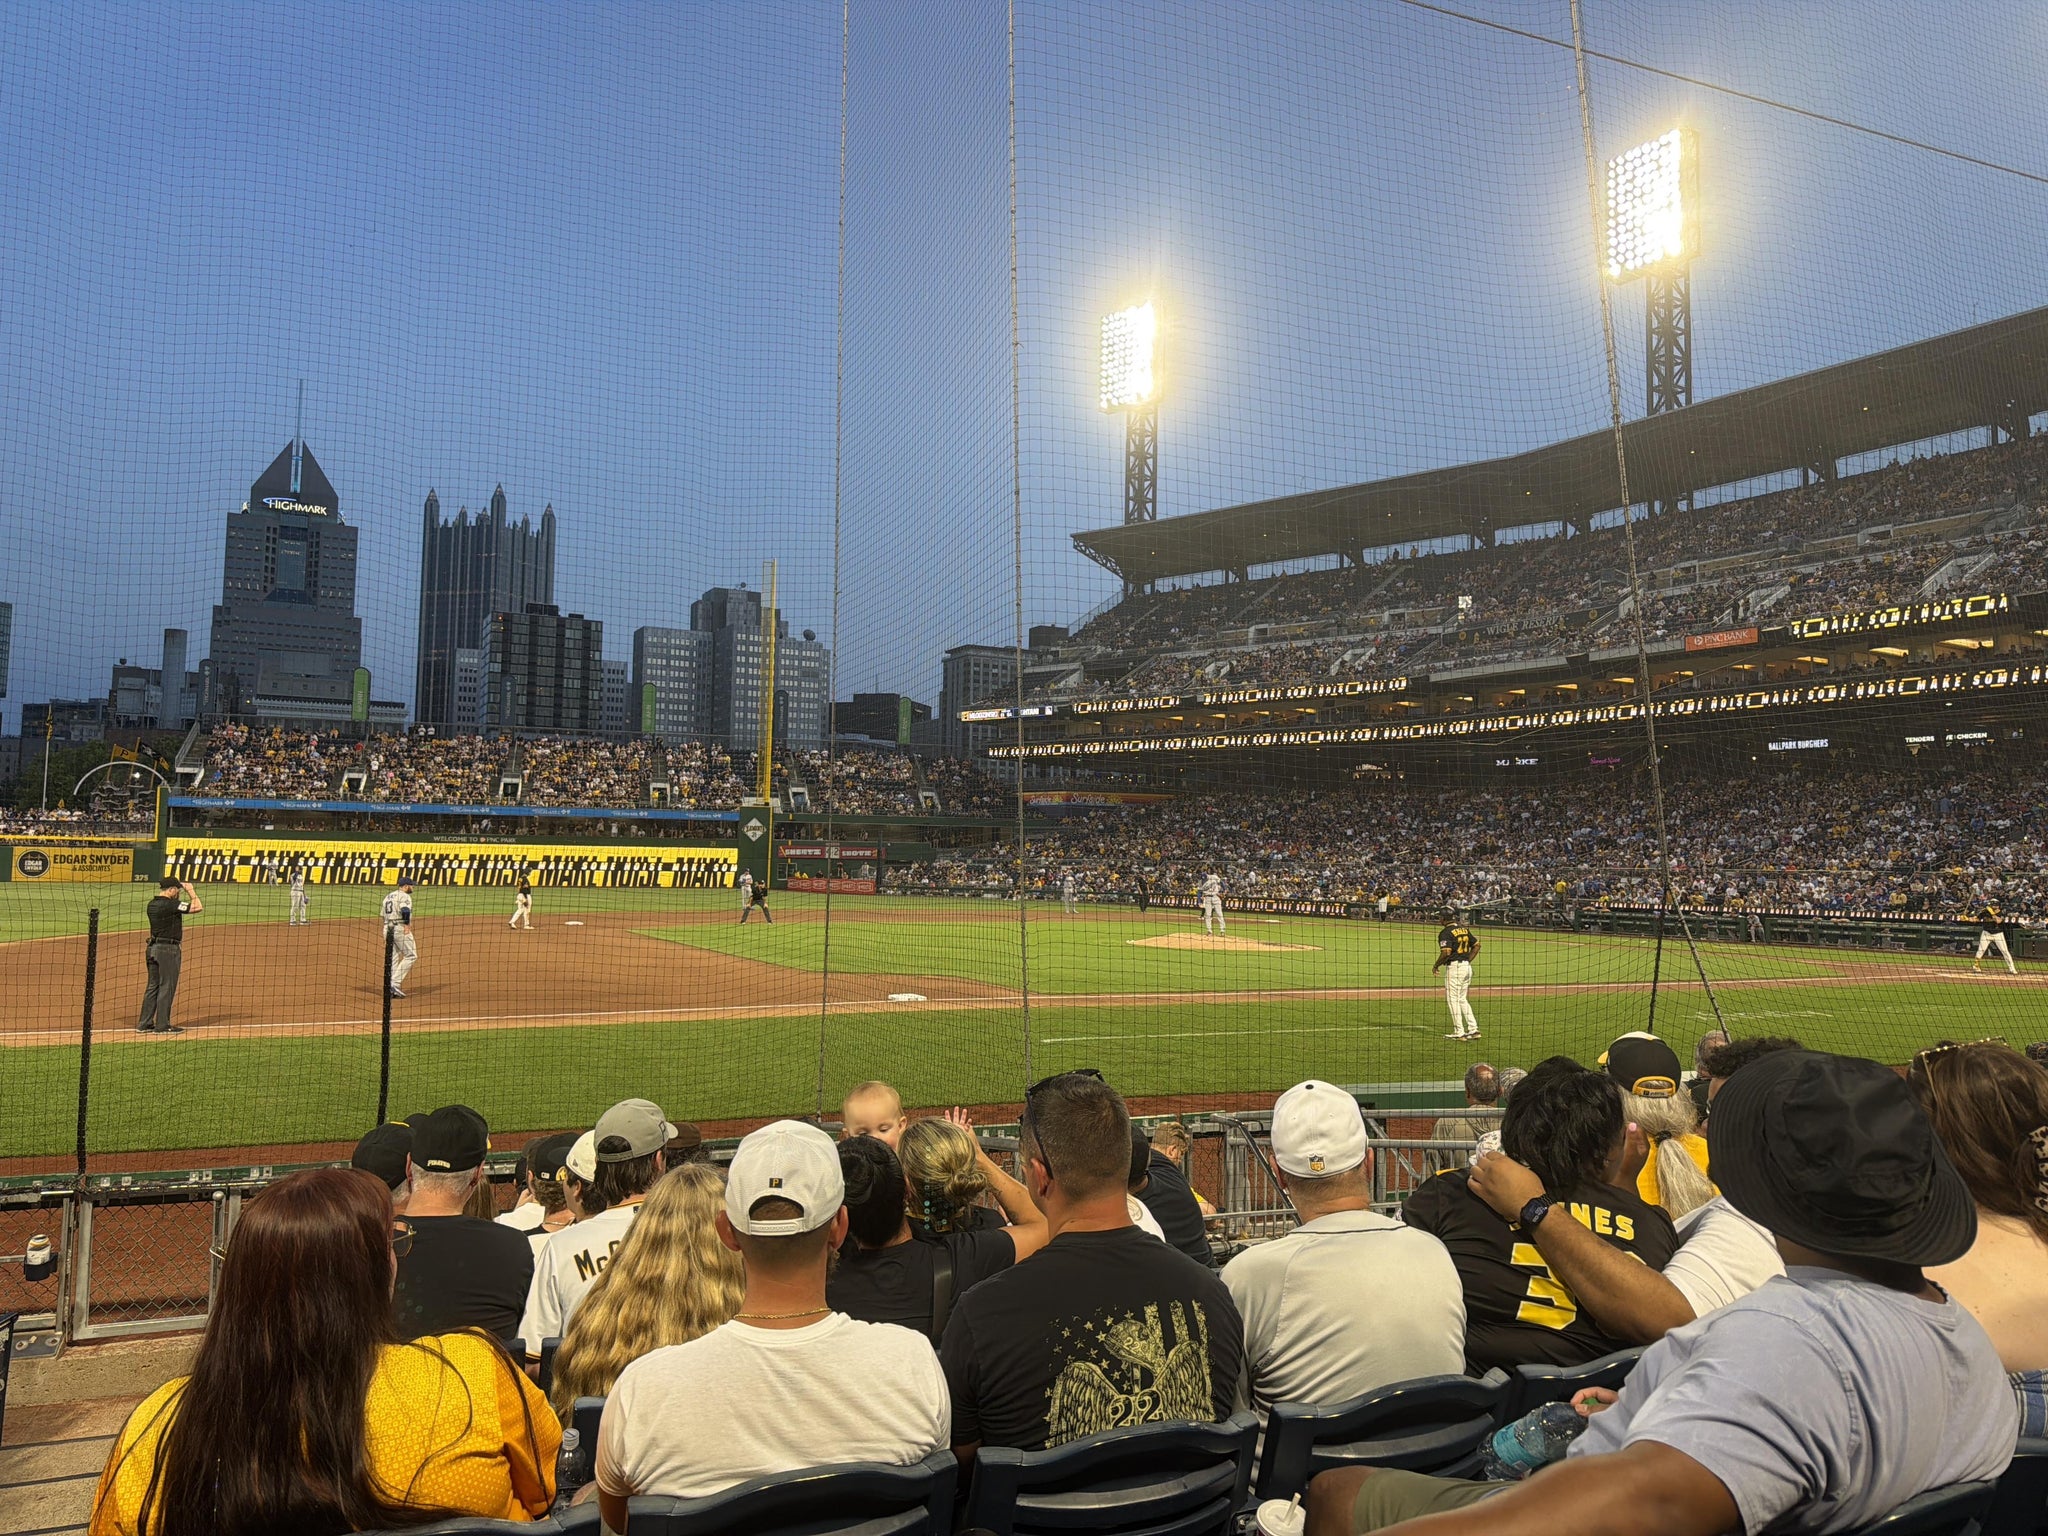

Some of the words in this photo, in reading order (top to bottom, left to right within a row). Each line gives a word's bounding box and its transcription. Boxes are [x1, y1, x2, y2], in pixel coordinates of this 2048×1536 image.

[269, 499, 327, 516] HIGHMARK
[1819, 617, 1860, 631] MAKE
[1868, 611, 1911, 625] SOME
[1920, 603, 1972, 619] NOISE
[1486, 622, 1518, 636] WIGLE
[1704, 633, 1722, 644] PNC
[1723, 630, 1748, 641] BANK
[1287, 687, 1312, 697] SOME
[1318, 684, 1350, 695] NOISE
[1357, 682, 1385, 692] MAKE
[1253, 736, 1277, 744] SOME
[1282, 735, 1312, 743] NOISE
[1318, 733, 1345, 741] MAKE
[1351, 731, 1377, 740] SOME
[1384, 729, 1414, 738] NOISE
[1419, 727, 1443, 735] MAKE
[1449, 724, 1474, 733] SOME
[1479, 721, 1510, 731] NOISE
[1517, 718, 1545, 727] MAKE
[1551, 714, 1580, 724] SOME
[1586, 709, 1622, 720] NOISE
[1630, 705, 1663, 717] MAKE
[1670, 701, 1703, 713] SOME
[1710, 697, 1750, 708] NOISE
[1761, 692, 1798, 705] MAKE
[1807, 687, 1847, 700] SOME
[1856, 682, 1905, 696] NOISE
[1917, 677, 1962, 691] MAKE
[1973, 671, 2019, 685] SOME
[1904, 735, 1935, 743] TENDERS
[1956, 732, 1988, 740] CHICKEN
[1768, 740, 1797, 751] BALLPARK
[1797, 738, 1829, 749] BURGHERS
[120, 749, 129, 758] P
[433, 835, 469, 843] WELCOME
[53, 854, 86, 864] EDGAR
[89, 854, 130, 865] SNYDER
[194, 855, 240, 865] NOISE
[250, 856, 290, 866] MAKE
[298, 856, 336, 867] SOME
[344, 857, 387, 868] NOISE
[397, 858, 435, 868] MAKE
[442, 859, 479, 869] SOME
[486, 860, 528, 870] NOISE
[538, 861, 574, 870] MAKE
[581, 861, 616, 871] SOME
[624, 862, 663, 871] NOISE
[672, 862, 706, 872] MAKE
[713, 863, 738, 872] SOM
[78, 864, 111, 872] ASSOCIATES
[658, 1120, 667, 1143] P
[427, 1159, 451, 1169] PIRATES
[771, 1178, 780, 1187] P
[1556, 1201, 1635, 1241] NES
[1109, 1388, 1163, 1430] 22
